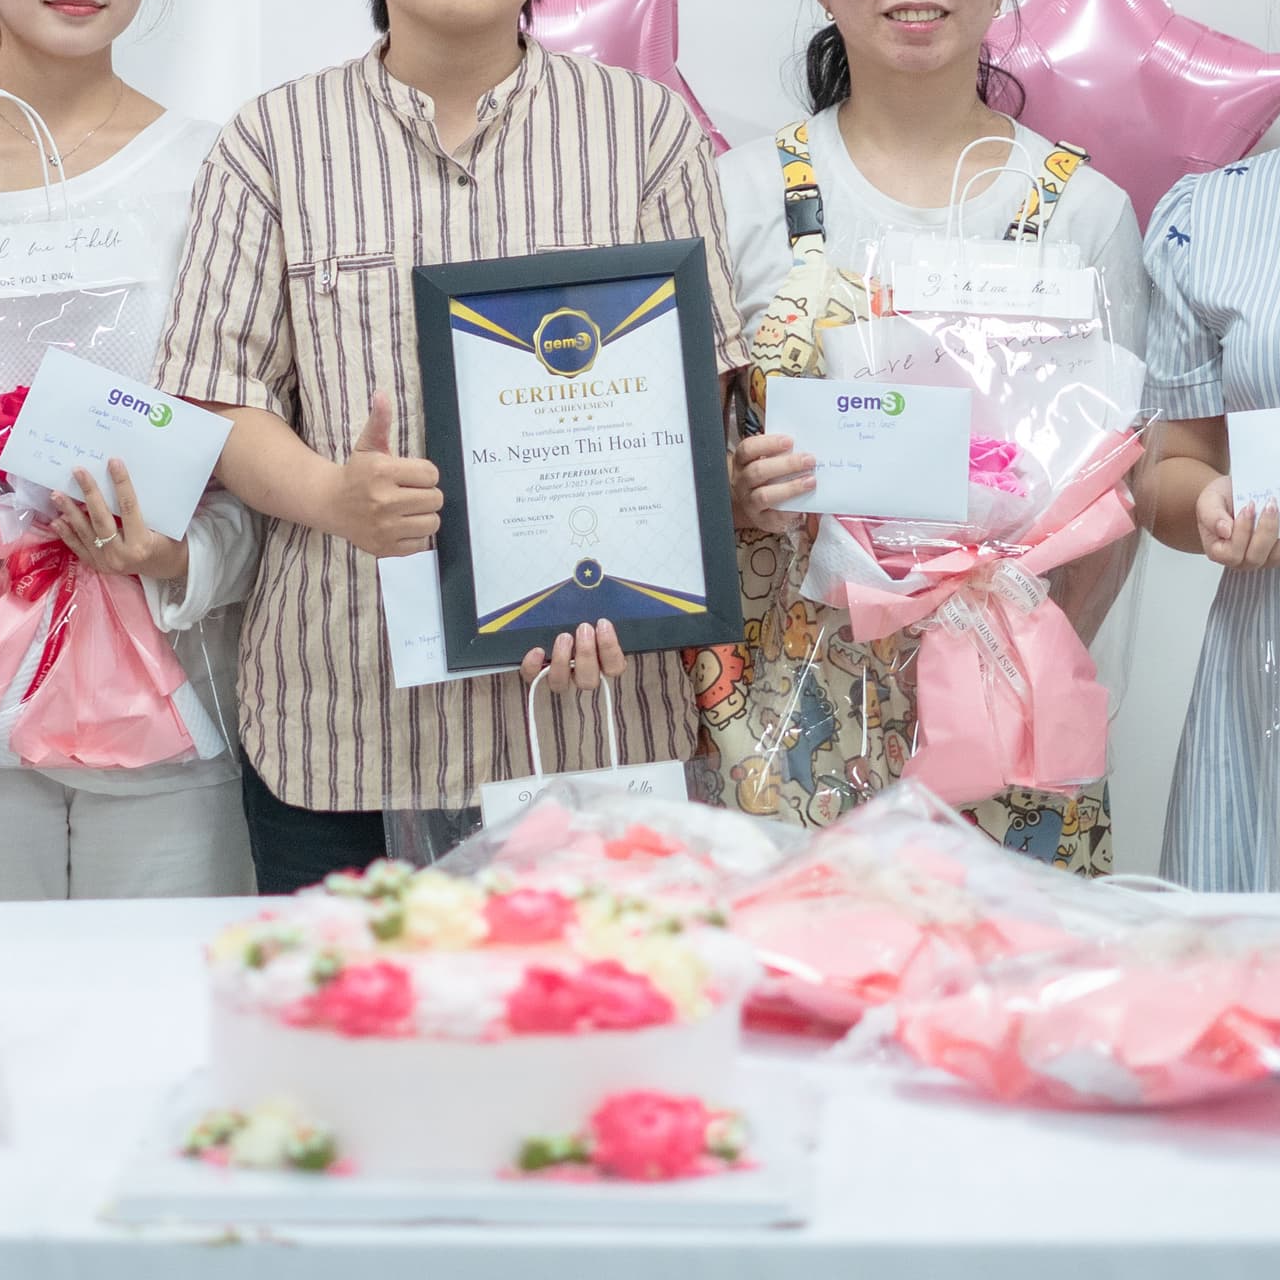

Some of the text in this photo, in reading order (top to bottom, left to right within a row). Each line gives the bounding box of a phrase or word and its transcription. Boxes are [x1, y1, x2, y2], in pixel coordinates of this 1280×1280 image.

[498, 376, 649, 406] CERTIFICATE
[535, 401, 615, 415] OF ACHIEVEMENT
[472, 430, 684, 464] Ms. Nguyen Thi Hoai Thu
[539, 471, 560, 481] BEST
